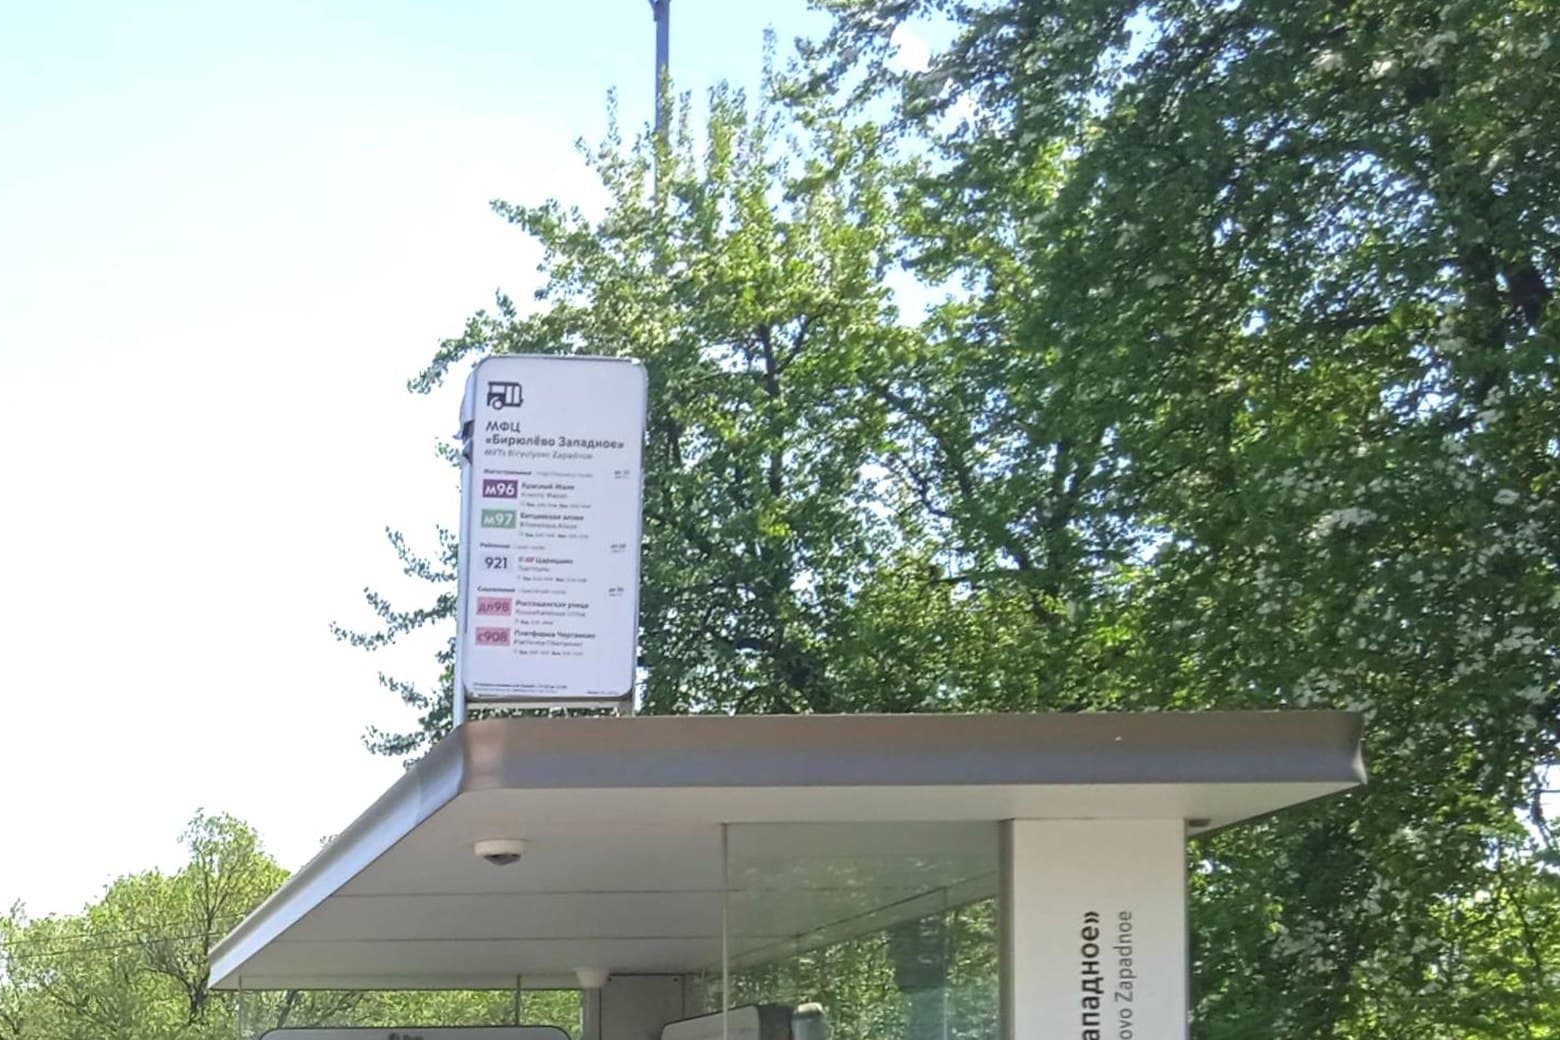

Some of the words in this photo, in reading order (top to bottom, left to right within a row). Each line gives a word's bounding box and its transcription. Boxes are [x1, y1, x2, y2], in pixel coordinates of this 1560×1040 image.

[485, 421, 521, 433] МФЦ
[485, 557, 508, 569] 921
[1112, 910, 1138, 1003] Zapadnoe
